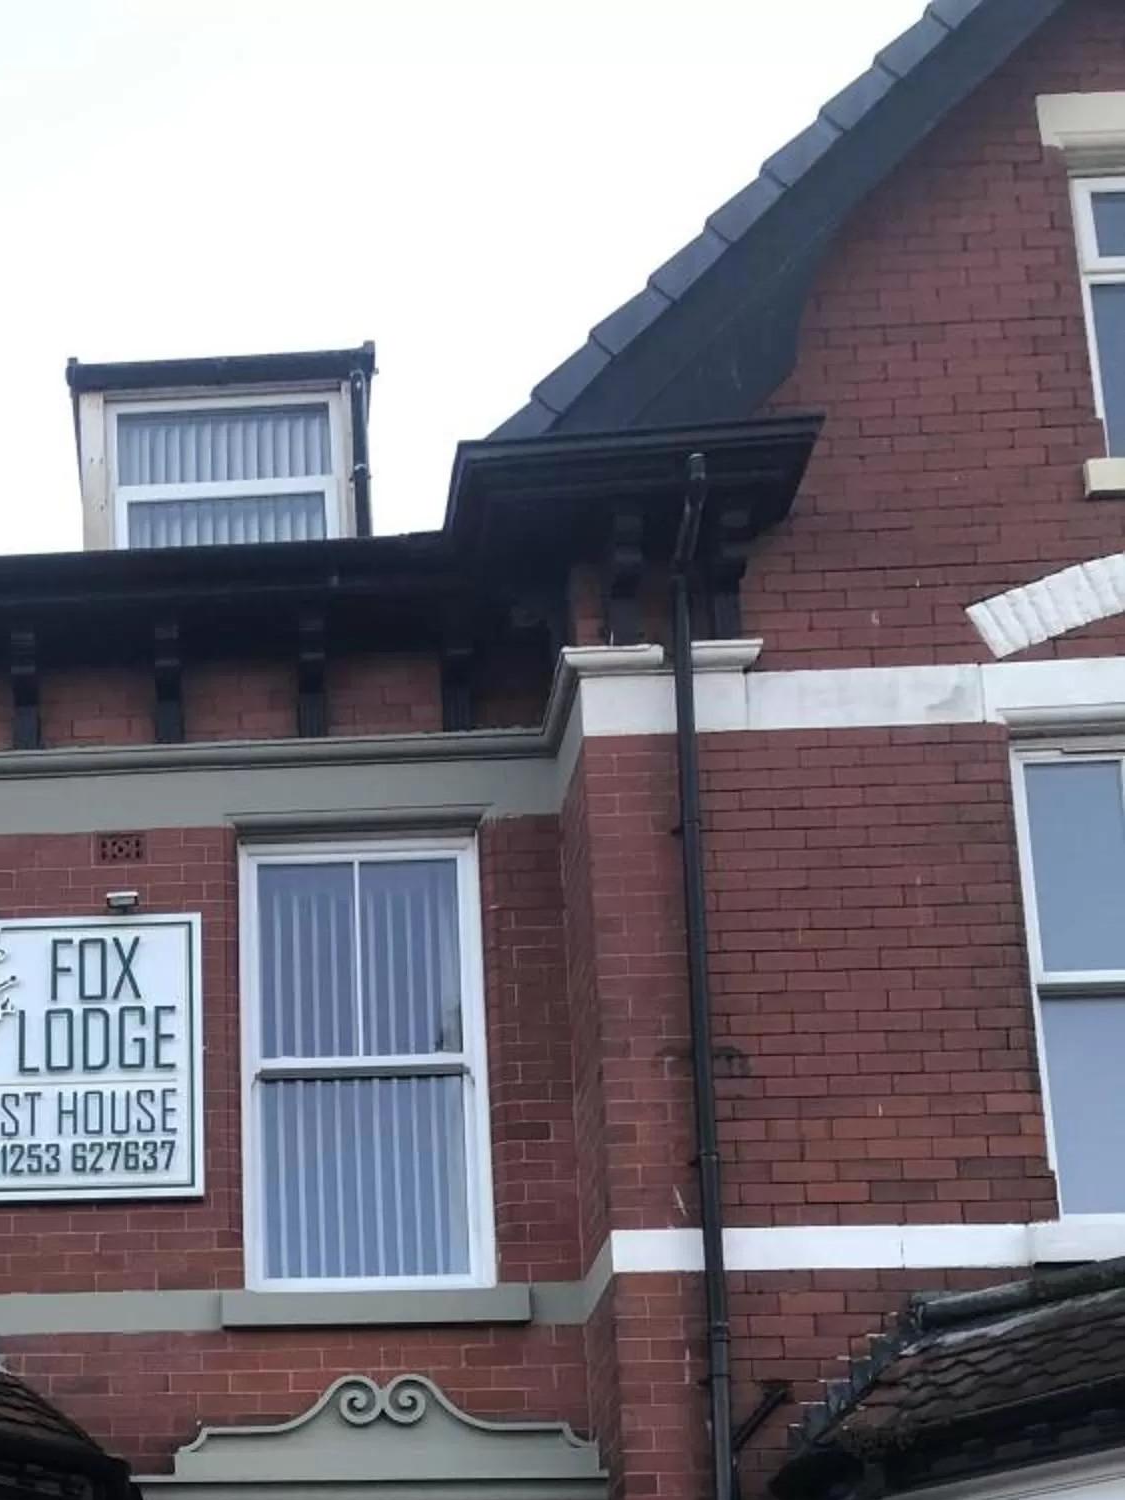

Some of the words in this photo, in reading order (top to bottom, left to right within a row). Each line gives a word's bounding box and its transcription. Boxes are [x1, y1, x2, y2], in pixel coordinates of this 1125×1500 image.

[50, 936, 142, 1001] FOX
[18, 1005, 177, 1073] LODGE
[57, 1088, 178, 1136] HOUSE
[71, 1140, 176, 1173] 627637
